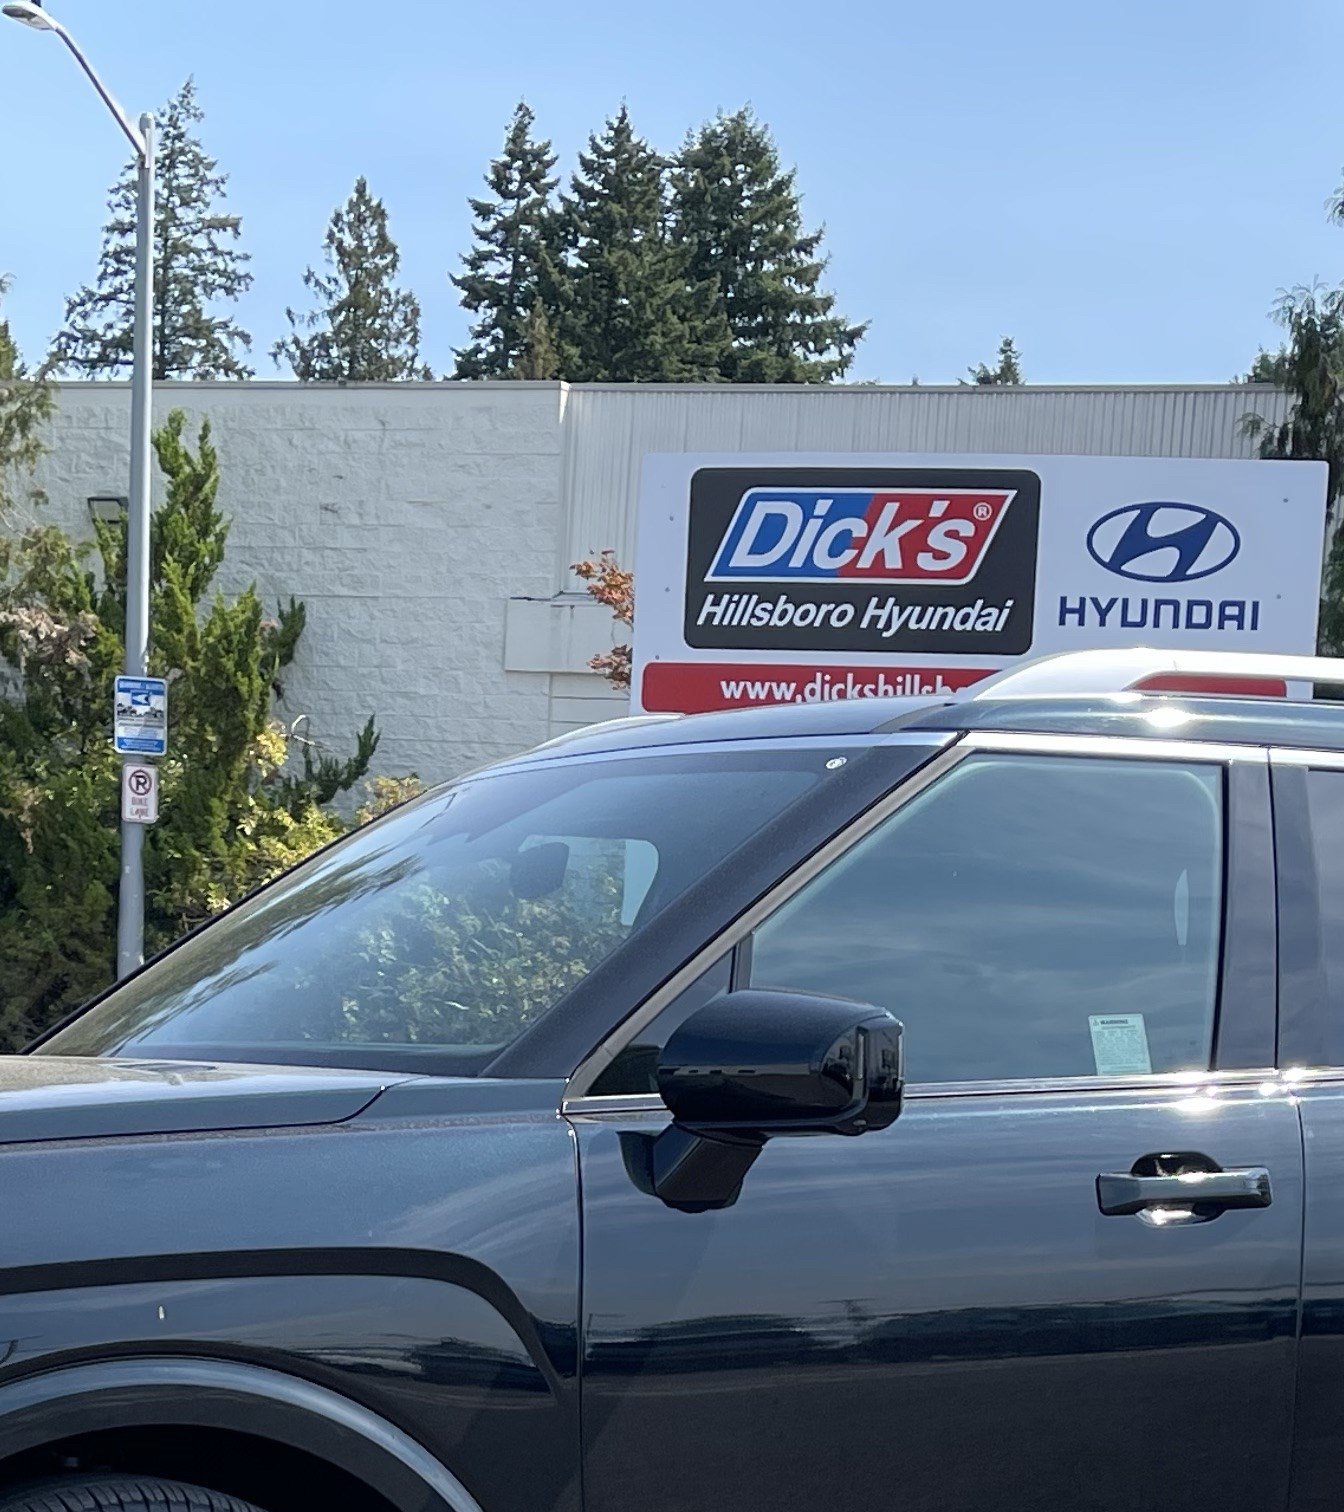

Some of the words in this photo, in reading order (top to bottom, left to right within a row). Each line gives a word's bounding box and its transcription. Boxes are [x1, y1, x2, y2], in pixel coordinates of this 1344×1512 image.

[696, 593, 855, 628] Hillsboro
[859, 596, 1014, 637] Hyundai
[1058, 595, 1260, 632] HYUNDAI
